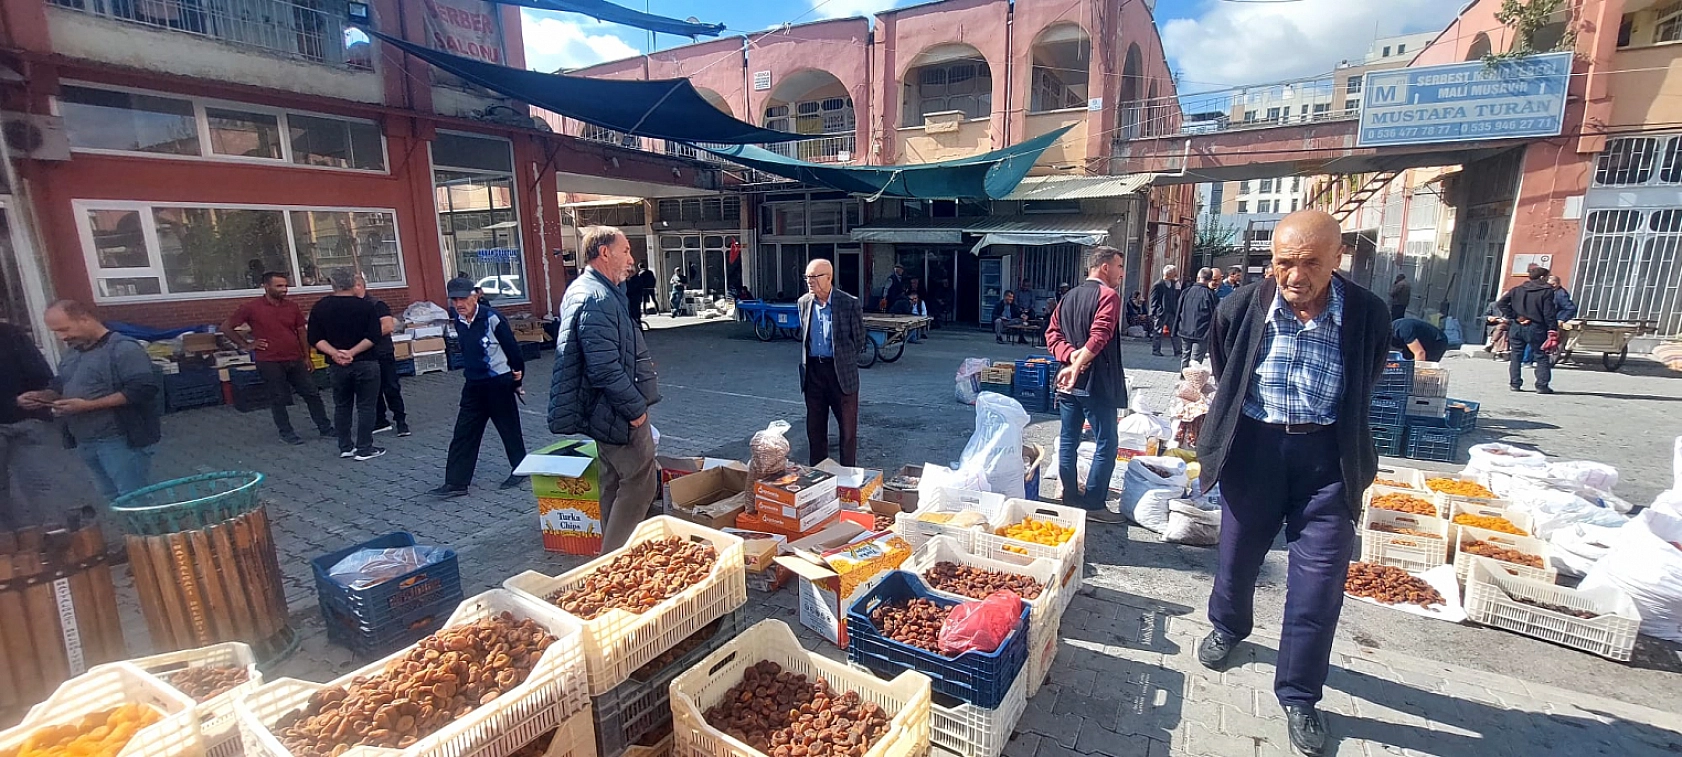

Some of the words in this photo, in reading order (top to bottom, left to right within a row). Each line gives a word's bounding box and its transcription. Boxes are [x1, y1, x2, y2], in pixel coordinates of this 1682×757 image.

[1416, 72, 1470, 87] SERBEST
[1371, 106, 1468, 125] MUSTAFA
[1475, 99, 1553, 117] TURAN
[1367, 129, 1375, 139] 0
[1399, 126, 1418, 137] 477
[1421, 125, 1435, 136] 78
[1437, 124, 1451, 135] 77
[1461, 123, 1468, 133] 0
[1471, 121, 1492, 132] 535
[1494, 120, 1516, 131] 946
[1519, 119, 1535, 129] 27
[1538, 118, 1552, 128] 71
[557, 512, 581, 522] Turka
[560, 521, 581, 531] Chips
